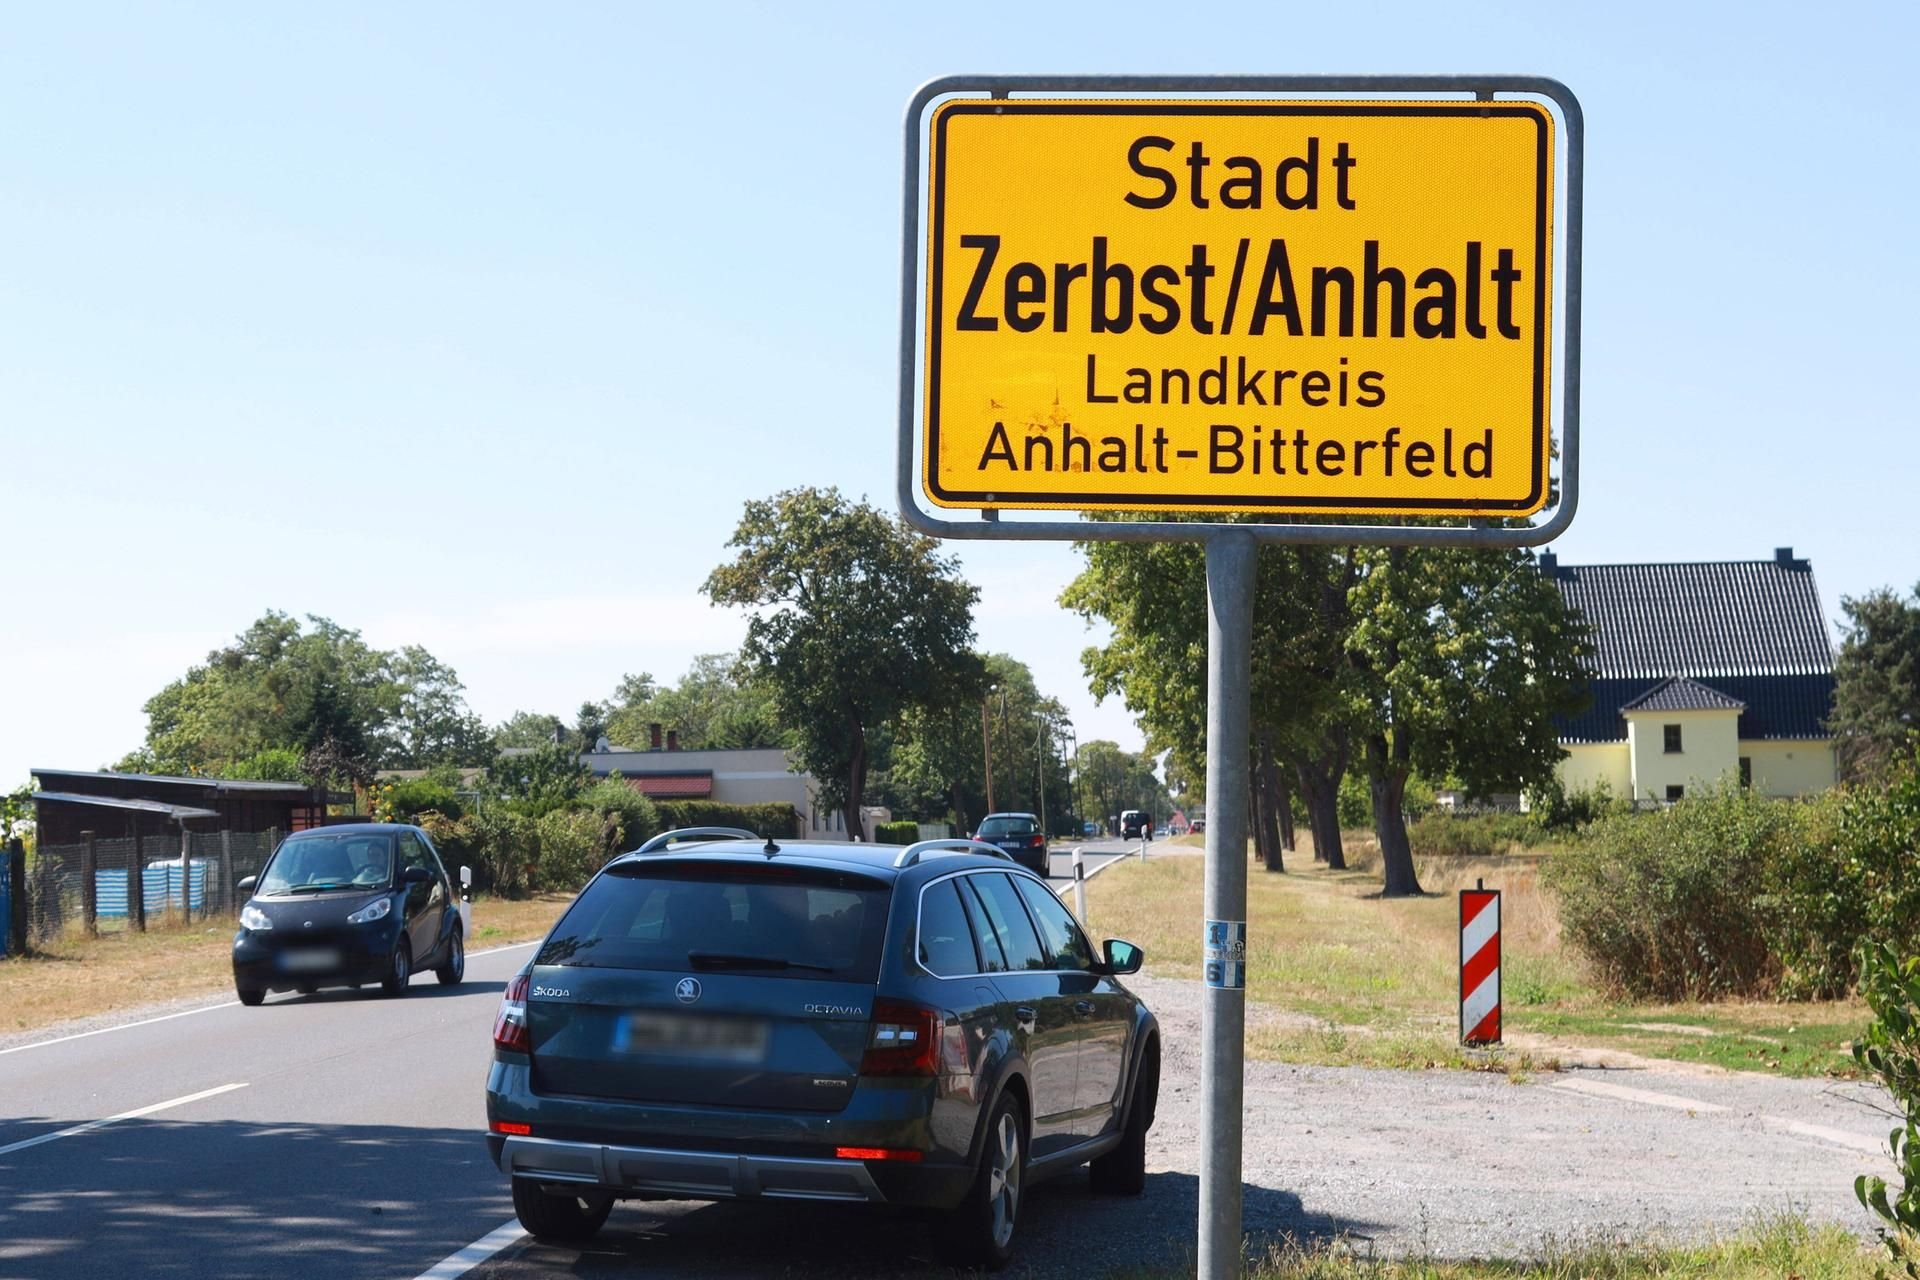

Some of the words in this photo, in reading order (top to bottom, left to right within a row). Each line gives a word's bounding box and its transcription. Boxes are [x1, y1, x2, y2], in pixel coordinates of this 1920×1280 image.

[1124, 135, 1357, 211] Stadt
[956, 234, 1522, 340] Zerbst/Anhalt
[1087, 354, 1386, 408] Landkreis
[978, 422, 1493, 479] Anhalt-Bitterfeld
[804, 1003, 863, 1016] OCTAVIA
